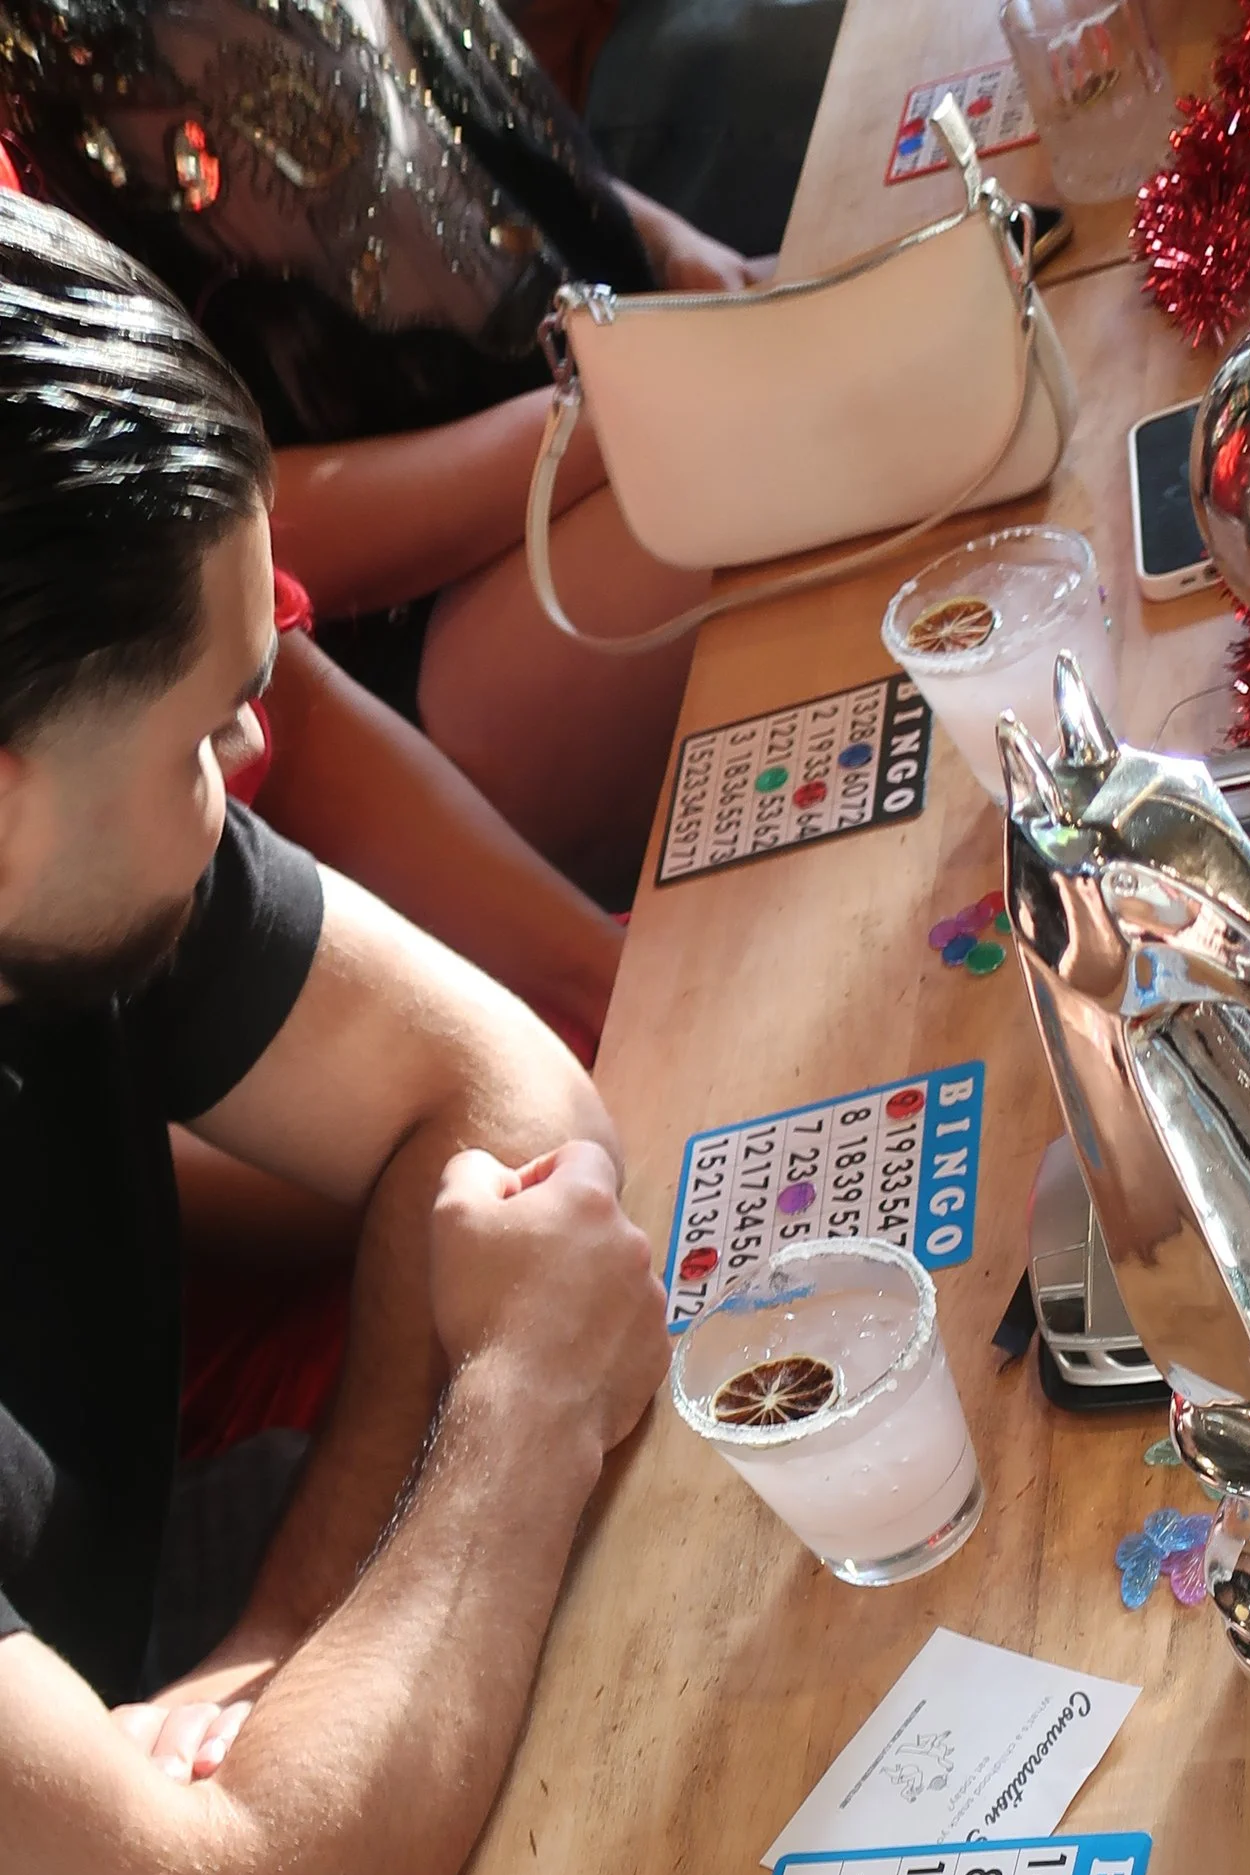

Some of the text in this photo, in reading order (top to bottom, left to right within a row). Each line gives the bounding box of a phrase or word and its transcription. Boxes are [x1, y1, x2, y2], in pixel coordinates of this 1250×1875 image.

[667, 737, 717, 874] 15 23 34 59 71
[882, 681, 924, 813] BINGO
[728, 1126, 777, 1269] 12 17 34 56
[832, 1107, 872, 1202] 8 18 39
[877, 1123, 917, 1231] 19 33 54
[925, 1077, 974, 1256] BINGO
[673, 1138, 729, 1321] 15 21 36 72
[985, 1691, 1091, 1827] Conversation
